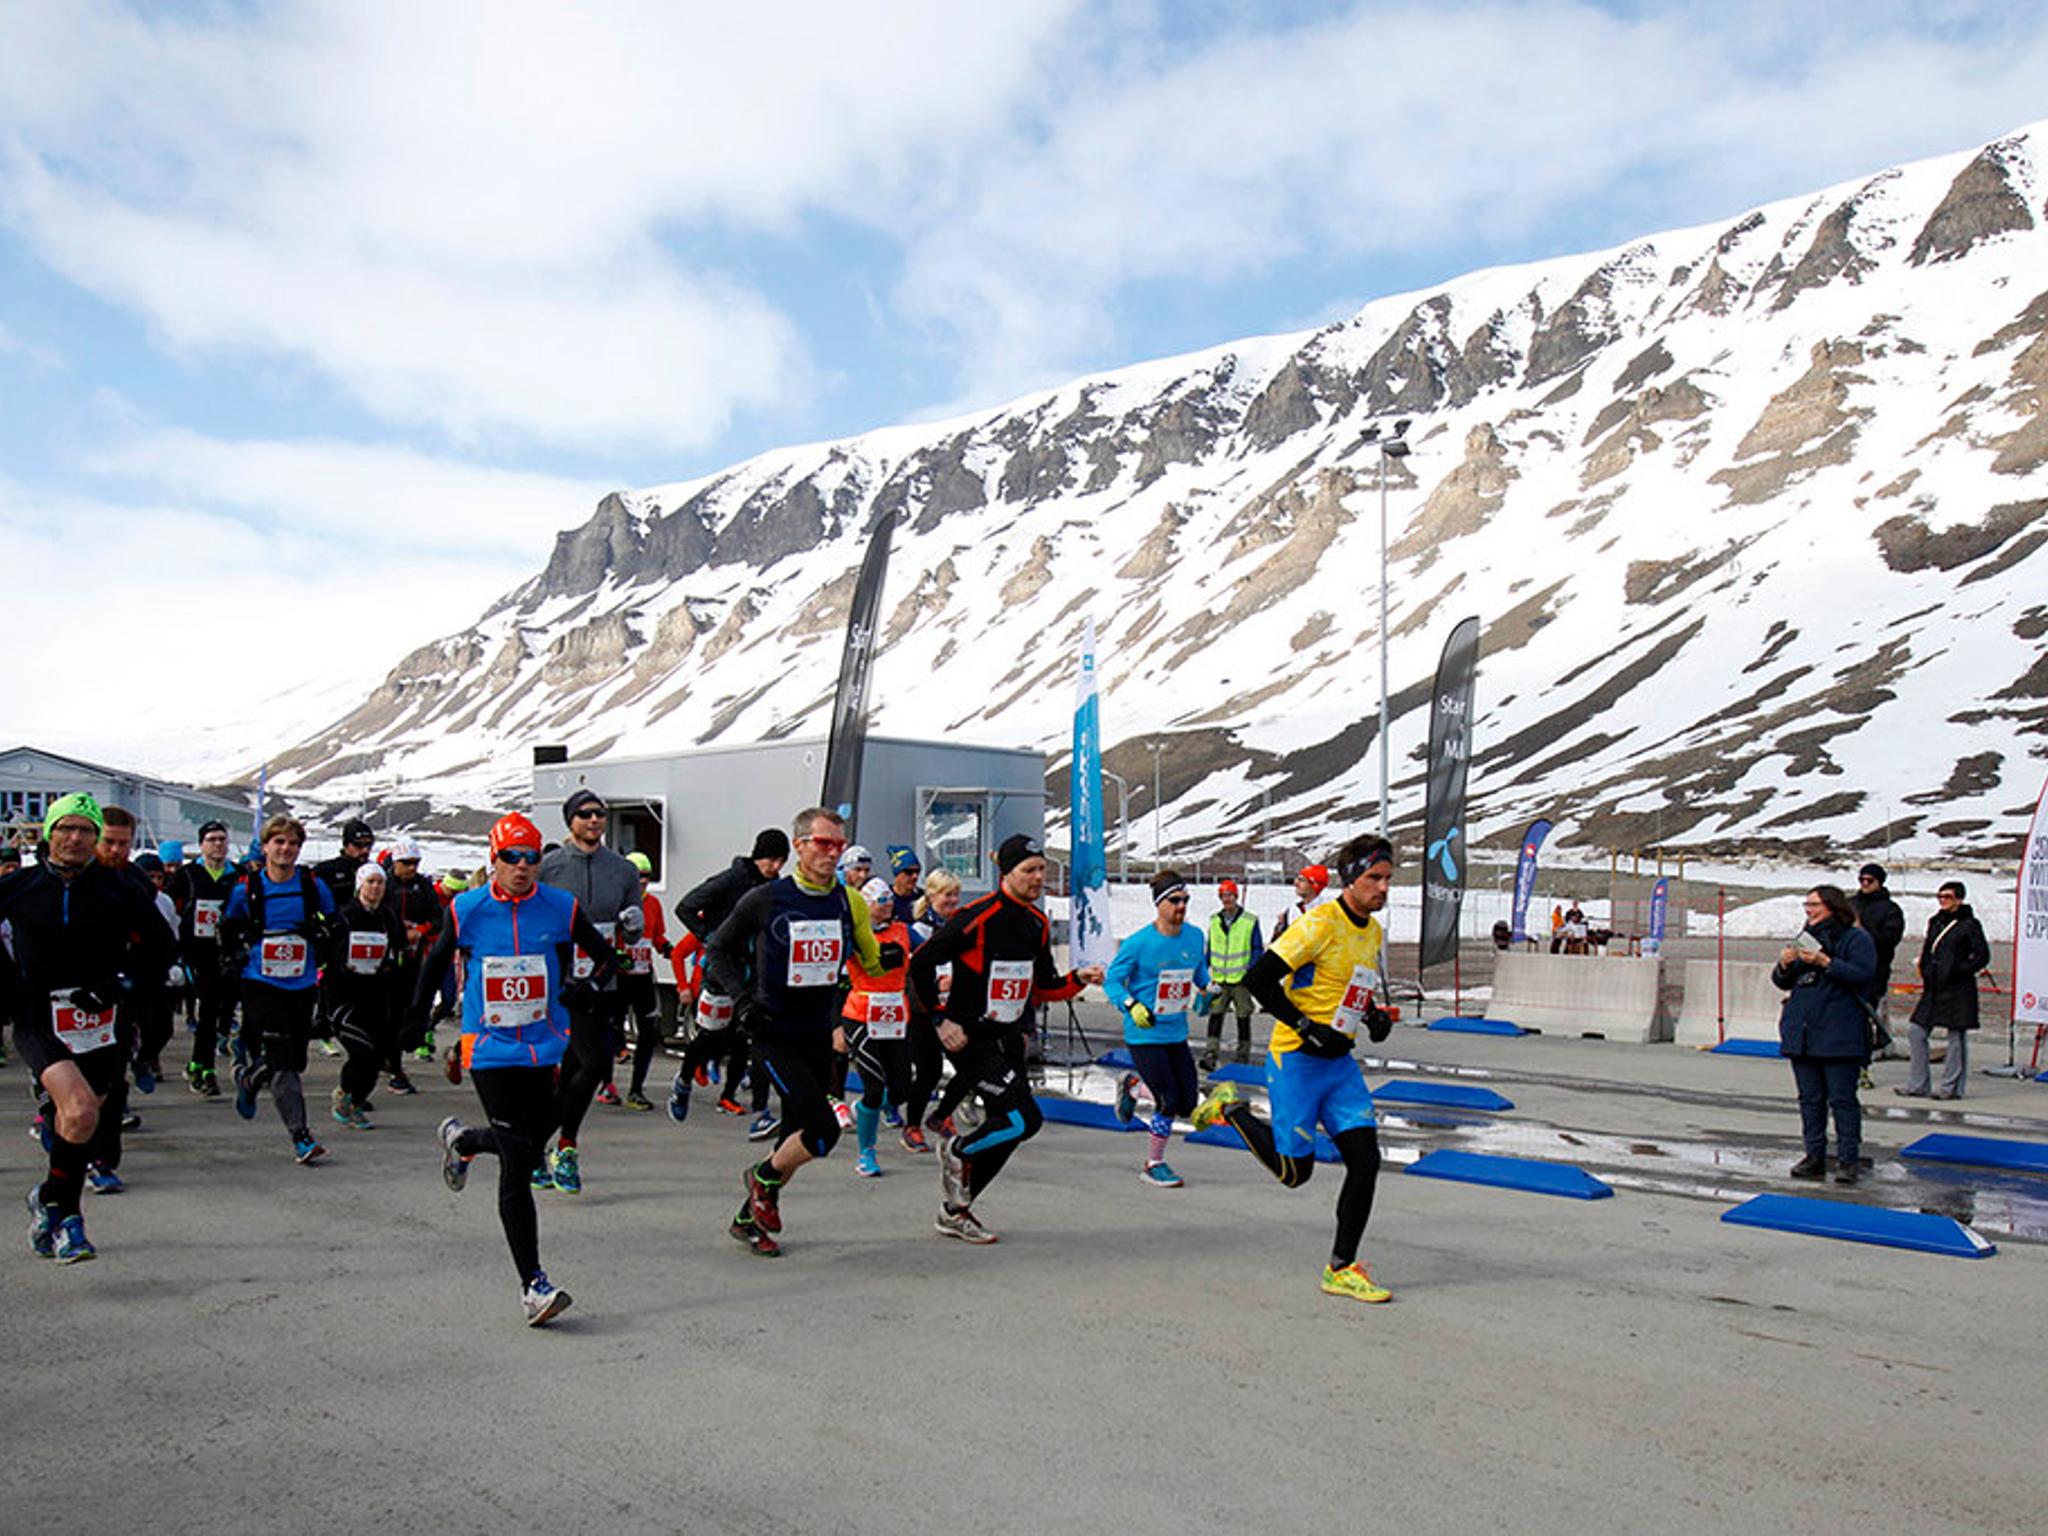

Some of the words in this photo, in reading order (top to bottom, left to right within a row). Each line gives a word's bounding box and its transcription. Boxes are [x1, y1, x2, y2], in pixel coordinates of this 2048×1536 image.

[801, 941, 833, 963] 105
[502, 977, 530, 1001] 60
[1001, 979, 1021, 999] 51
[879, 1005, 898, 1022] 25
